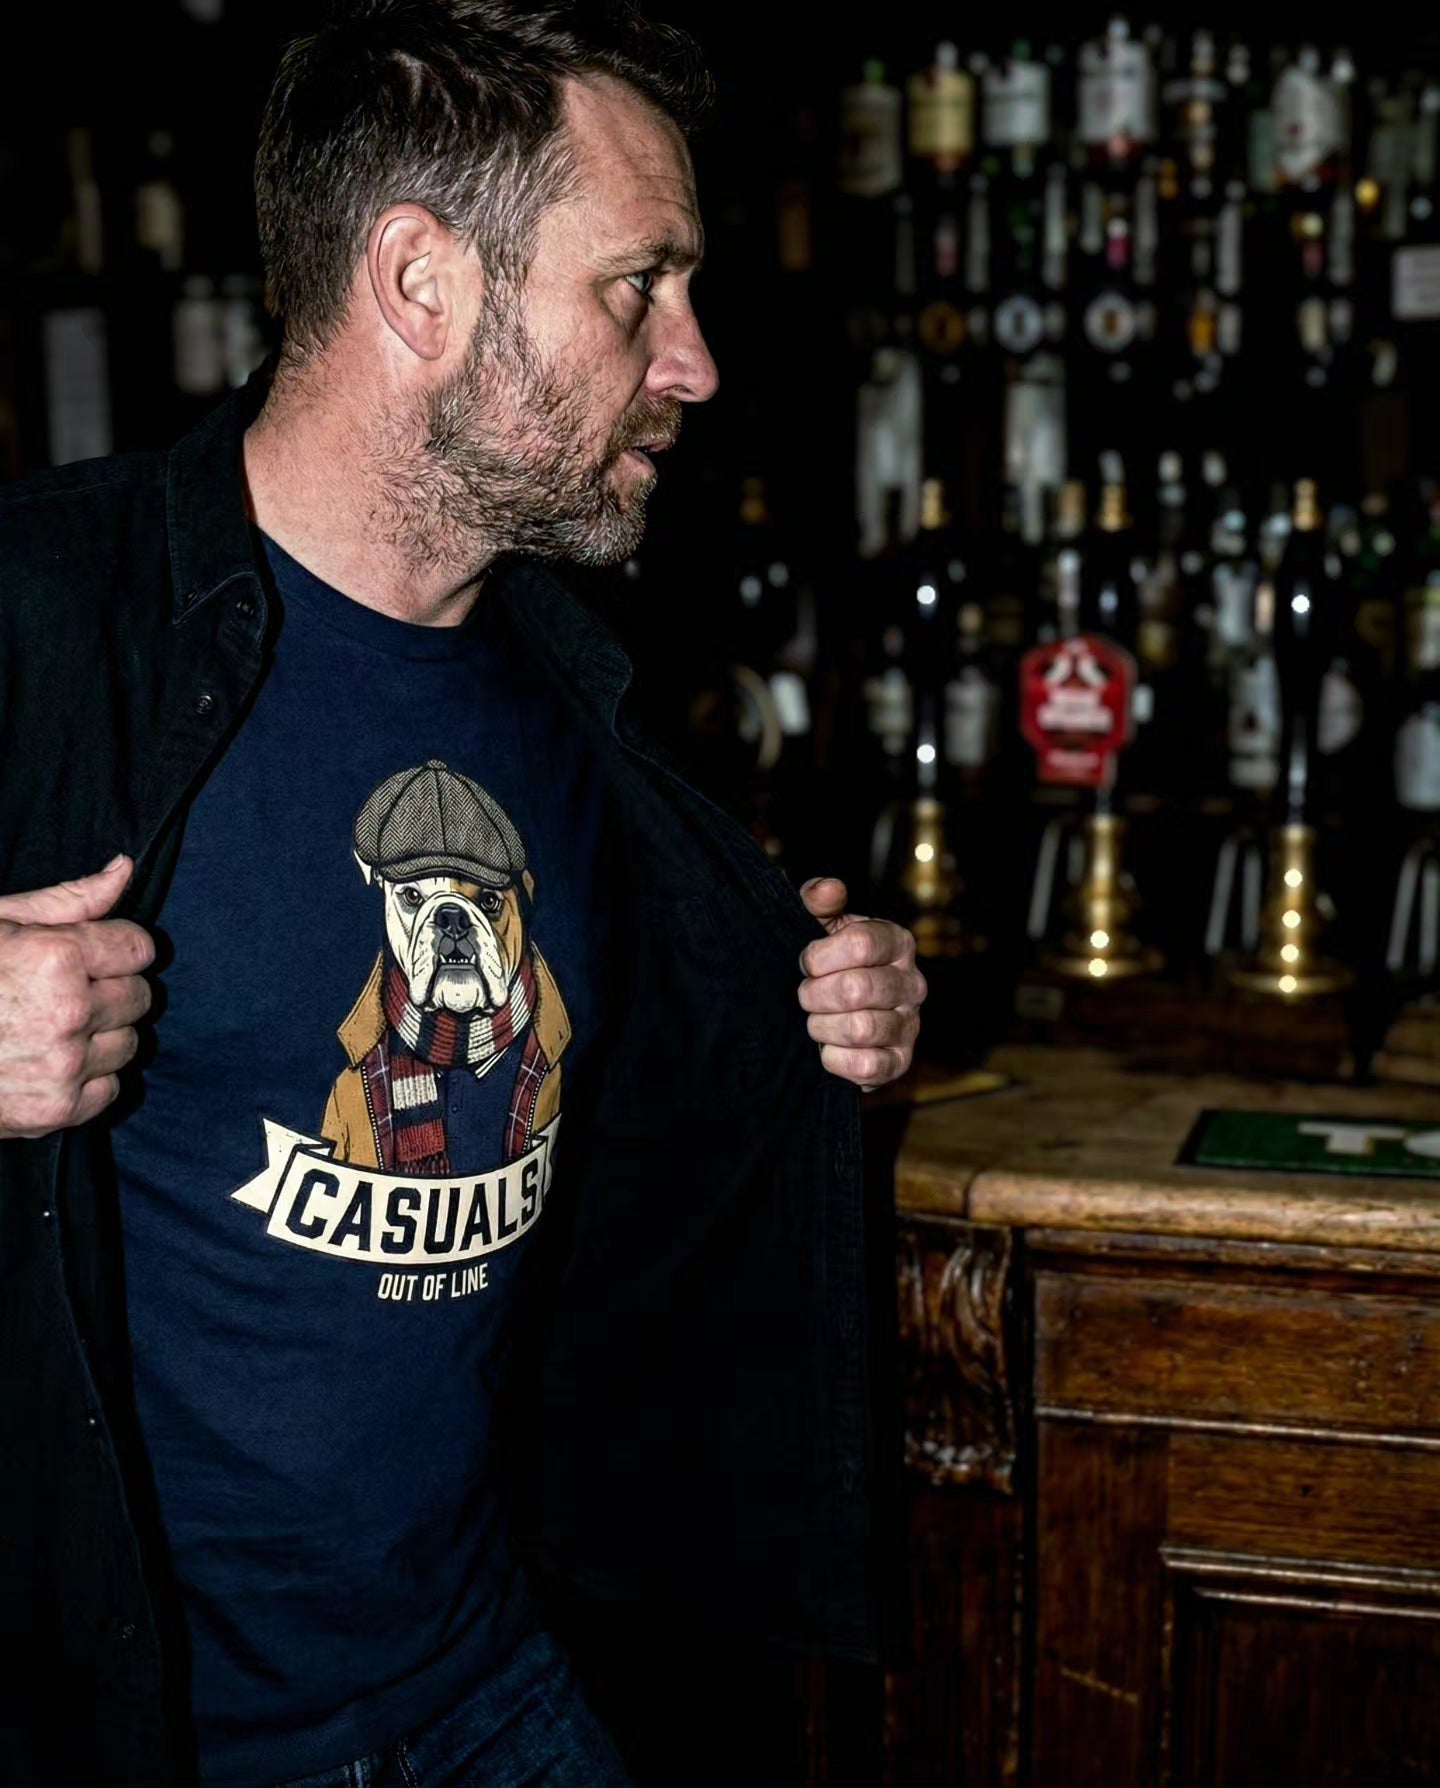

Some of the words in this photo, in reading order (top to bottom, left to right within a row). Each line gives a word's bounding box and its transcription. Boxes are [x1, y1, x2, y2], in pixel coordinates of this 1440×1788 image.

[286, 1161, 539, 1254] CASUALS
[377, 1273, 419, 1301] OUT
[422, 1271, 447, 1300] OF
[451, 1262, 489, 1298] LINE
